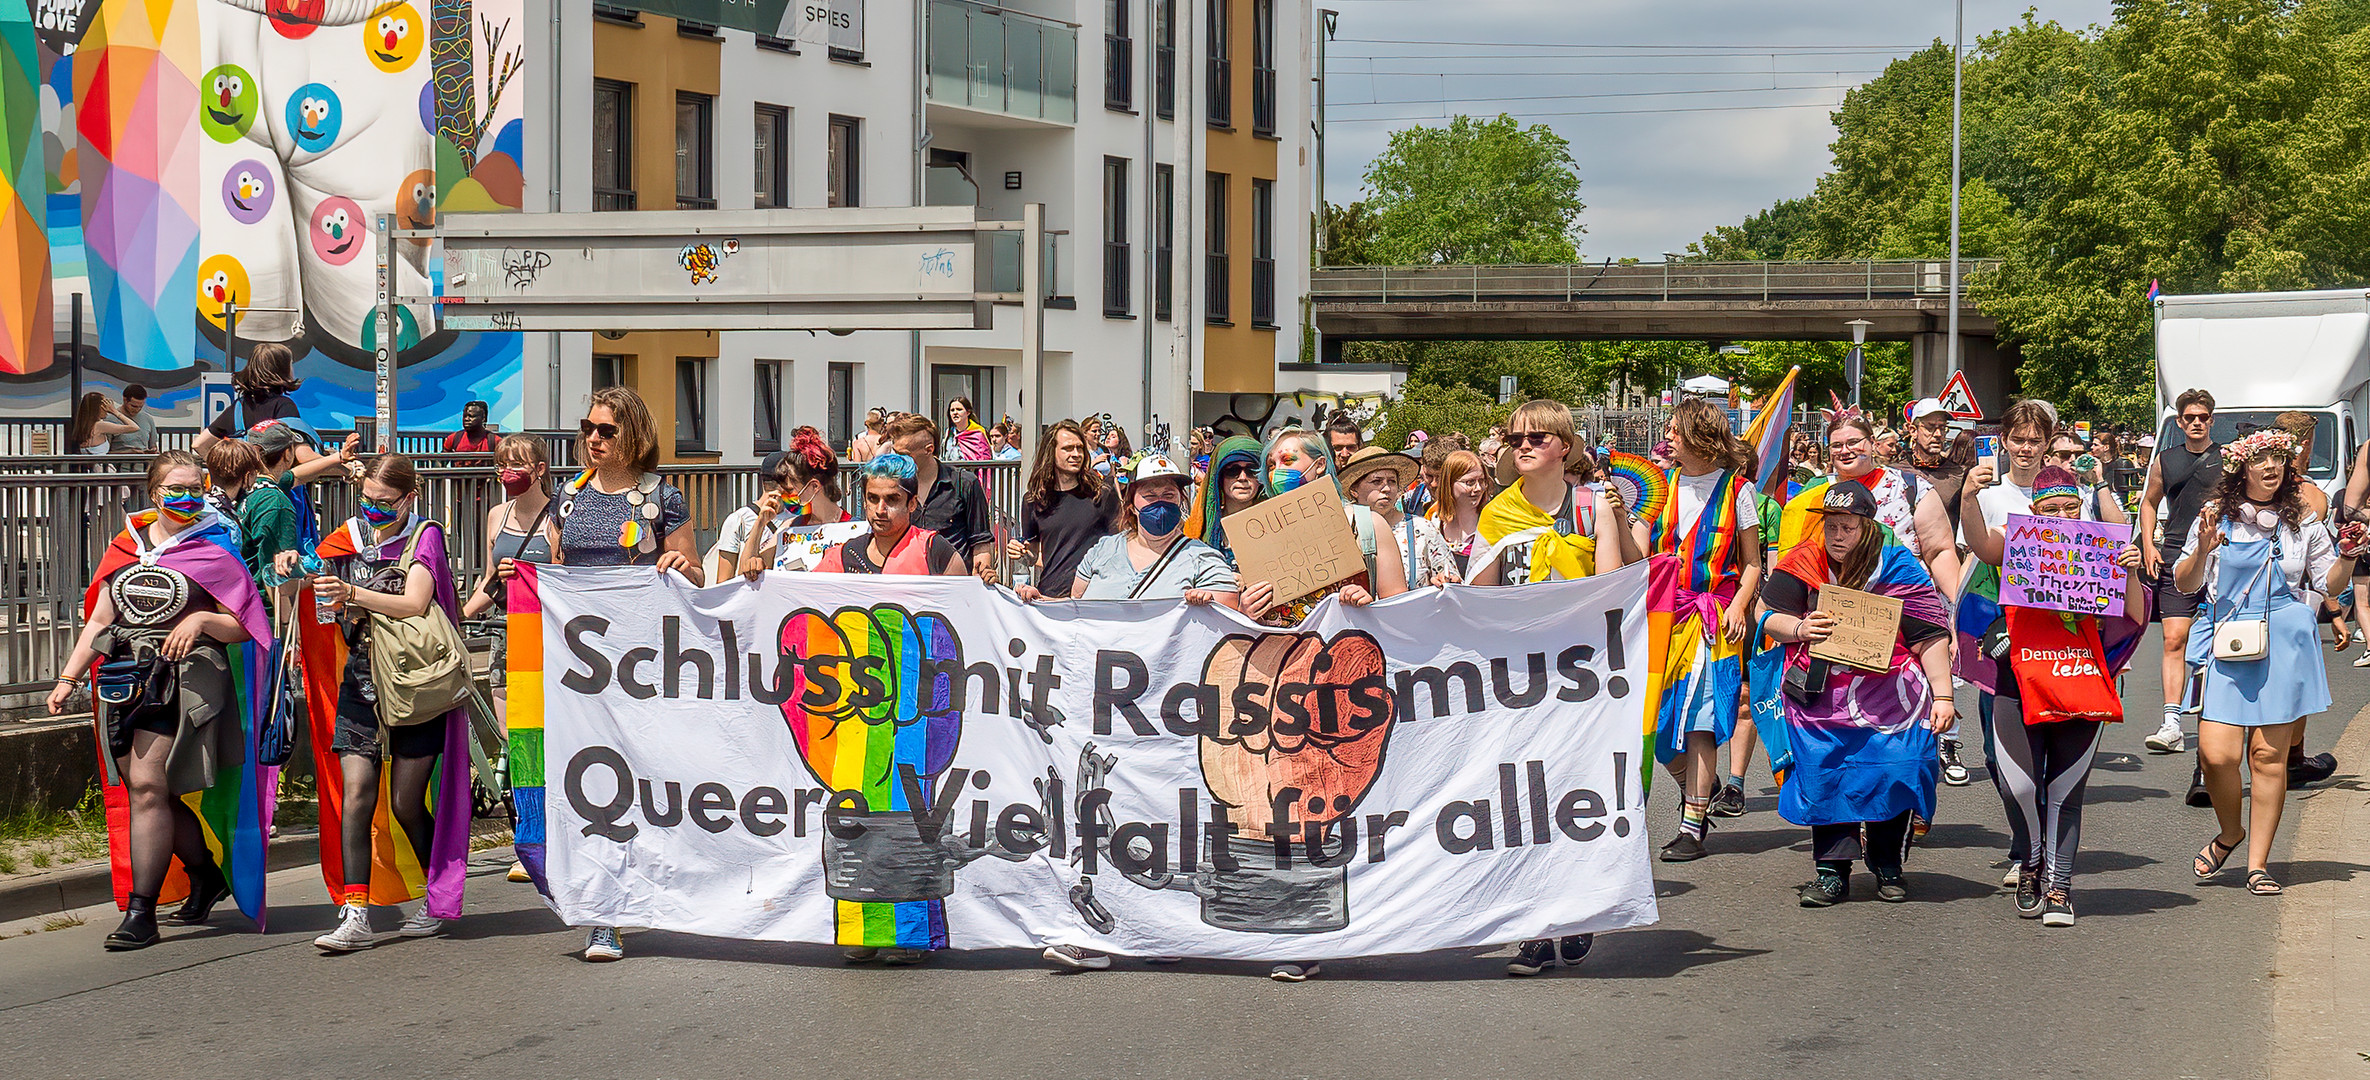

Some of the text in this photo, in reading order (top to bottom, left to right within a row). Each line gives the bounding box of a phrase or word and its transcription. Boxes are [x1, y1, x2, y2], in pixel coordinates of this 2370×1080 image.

[35, 12, 77, 33] LOVE
[805, 5, 850, 29] SPIES
[1245, 491, 1336, 540] QUEER
[782, 528, 824, 546] Respect
[2010, 525, 2072, 545] Mein
[1263, 536, 1345, 579] PEOPLE
[2009, 544, 2064, 561] Meine
[1276, 557, 1339, 597] EXIST
[2039, 561, 2085, 576] Mein
[2023, 588, 2062, 603] Toni
[2038, 574, 2125, 600] They/Them
[1828, 590, 1855, 609] Free
[1852, 633, 1886, 651] Kisses
[560, 608, 1630, 738] Schluss mit Rassismus!
[564, 745, 1630, 875] Queere Vielfalt für alle!
